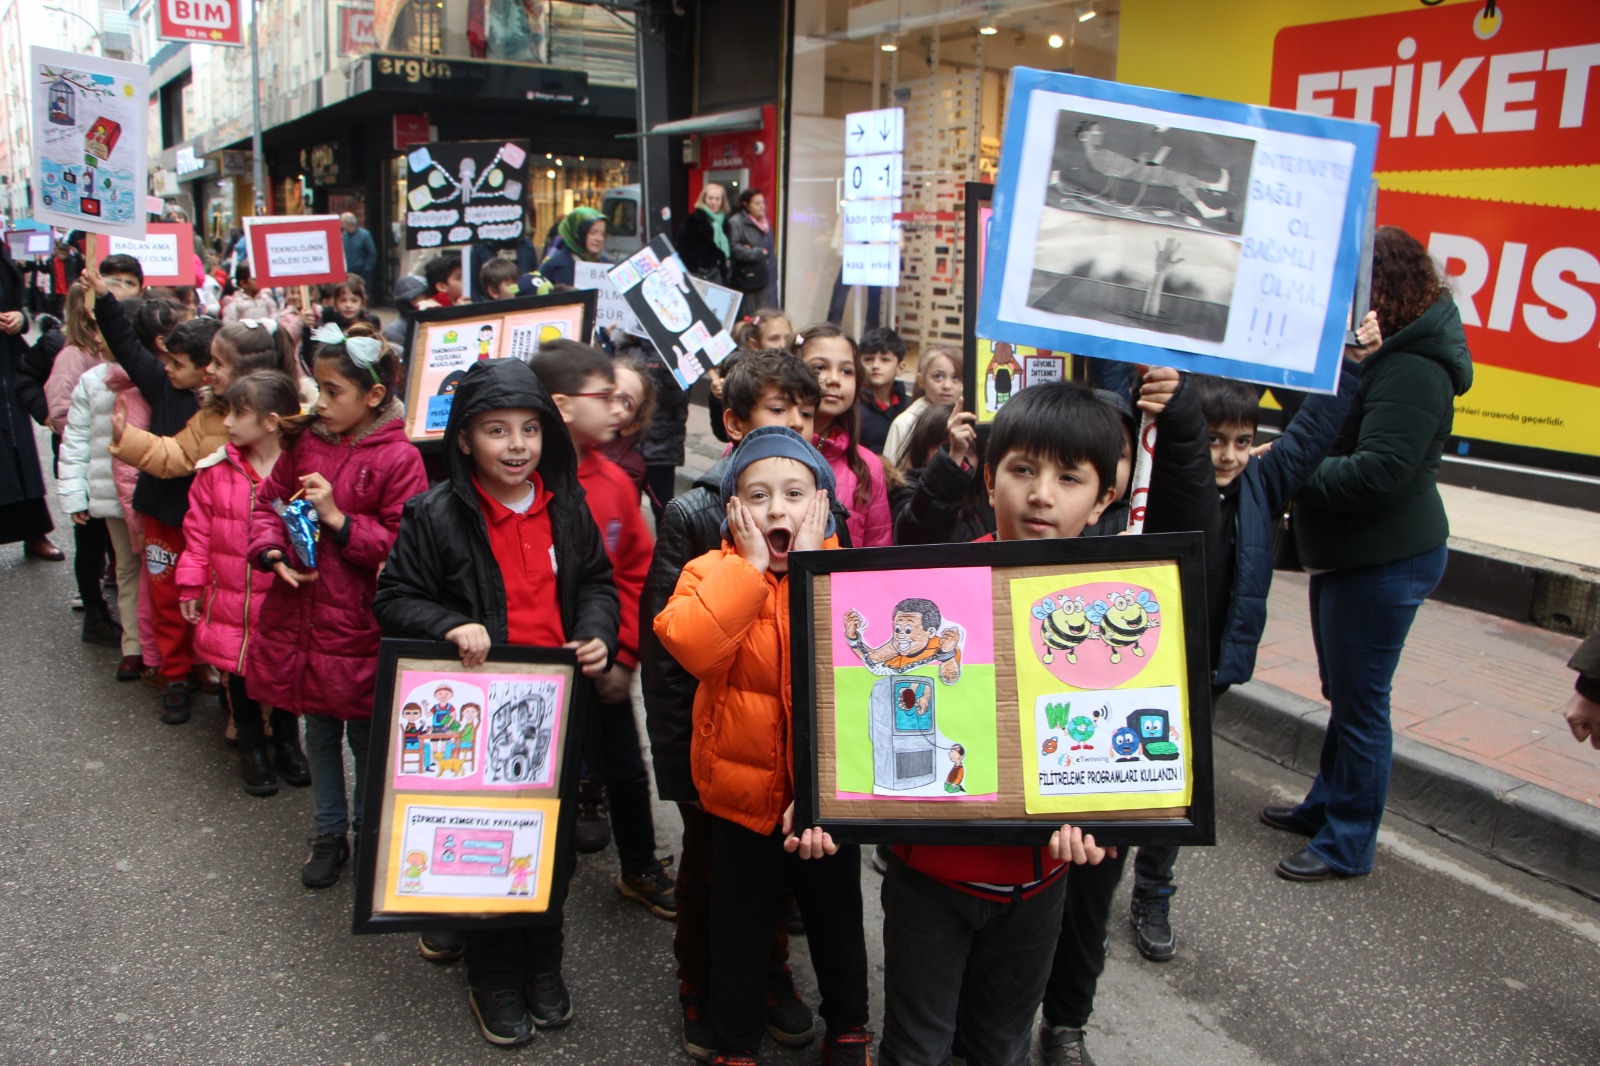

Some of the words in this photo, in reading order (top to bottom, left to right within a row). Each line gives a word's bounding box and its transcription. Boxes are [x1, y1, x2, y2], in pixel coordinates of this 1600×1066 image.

[378, 57, 451, 83] ergün
[1295, 37, 1600, 139] ETİKET
[712, 158, 743, 168] AKBANK
[853, 166, 863, 189] 0
[871, 214, 890, 227] çocu
[1287, 217, 1316, 240] OL
[115, 242, 150, 250] BAĞLAN
[149, 255, 174, 263] OLMA
[272, 256, 300, 265] KÖLESİ
[302, 255, 324, 264] OLMA
[1426, 232, 1600, 344] RIS
[596, 307, 624, 321] GÜR
[1033, 359, 1055, 367] GÜVENLİ
[1031, 369, 1057, 377] İNTERNET
[1453, 406, 1480, 416] arihleri
[1481, 410, 1519, 421] arasında
[1521, 414, 1565, 427] geçerlidir.
[146, 546, 178, 566] SNEY
[1076, 755, 1109, 763] eTwinning
[1039, 770, 1085, 786] FİLİTRELEME
[1088, 769, 1138, 784] PROGRAMLARI
[448, 815, 491, 825] KİMSEYLE
